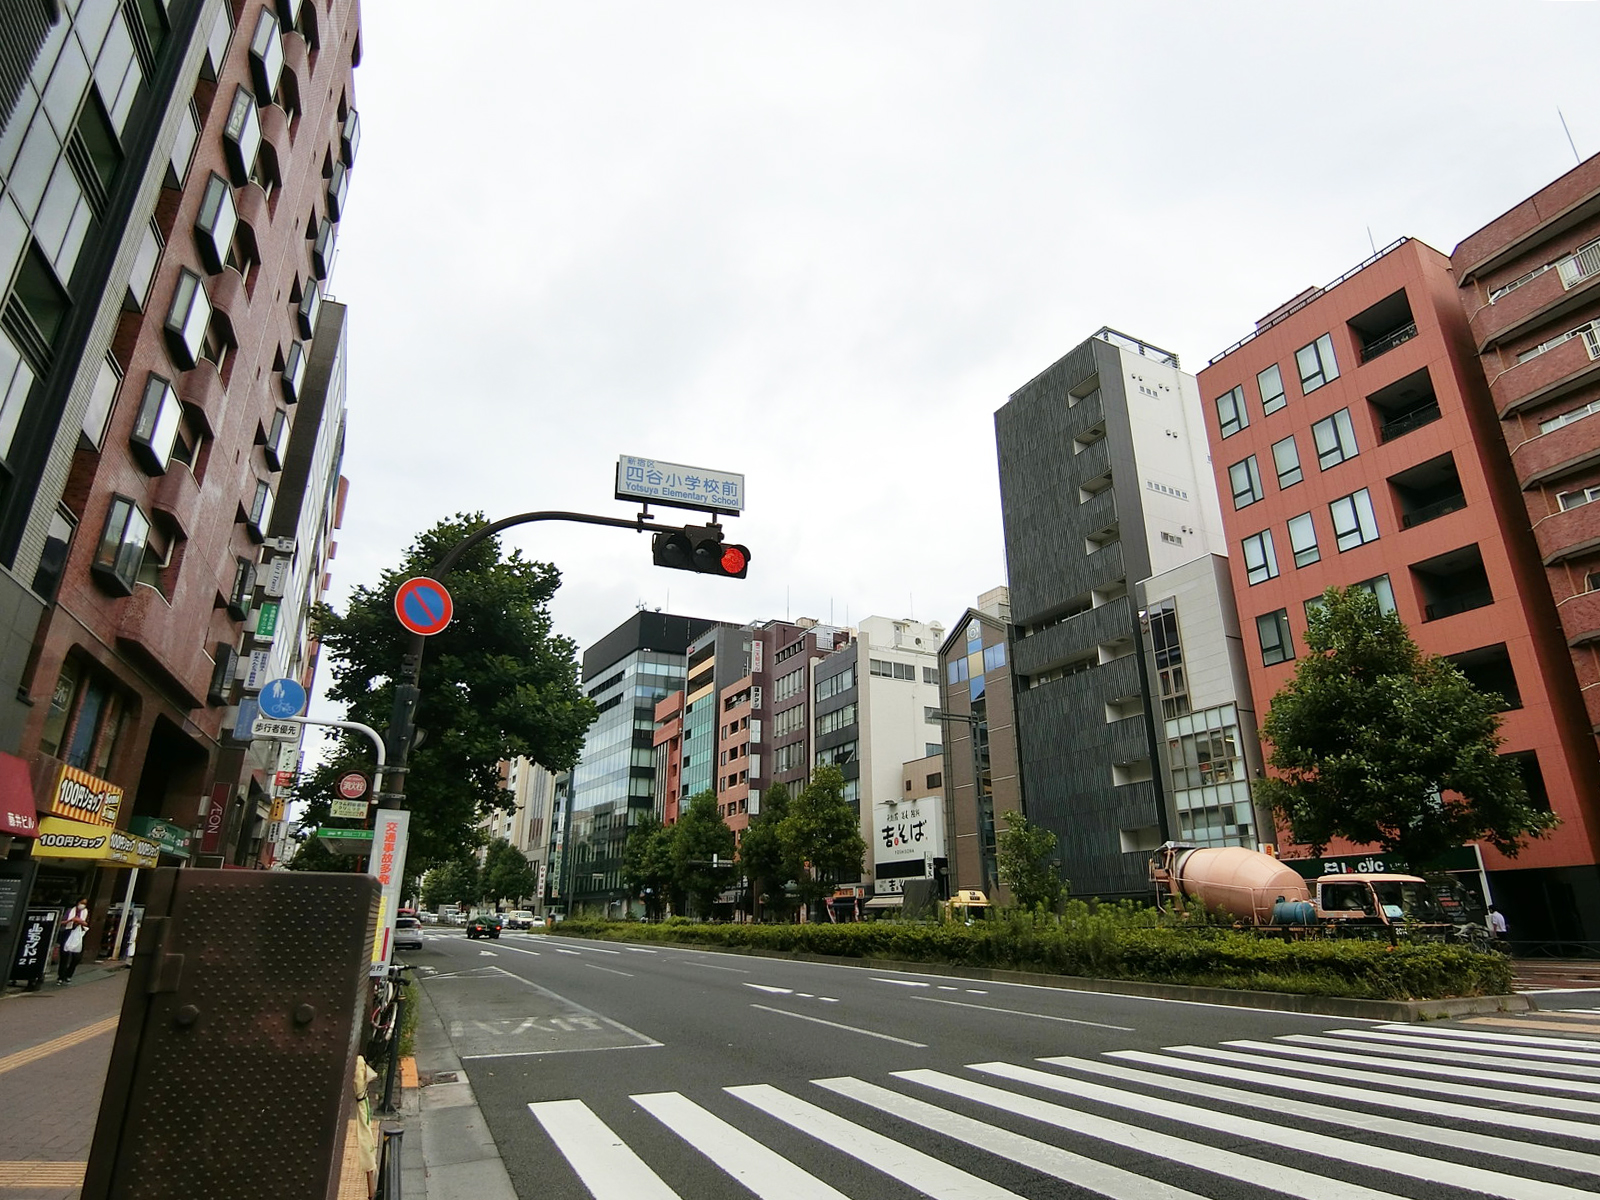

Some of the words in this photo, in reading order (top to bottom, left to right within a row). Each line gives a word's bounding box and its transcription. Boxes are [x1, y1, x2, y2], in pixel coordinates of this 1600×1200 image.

[625, 481, 659, 495] Yotsuya
[662, 487, 708, 504] Elementary
[711, 494, 739, 507] School
[626, 466, 738, 497] 四谷小学校前
[255, 722, 299, 736] 歩行者優先
[60, 778, 104, 813] 100円ショップ
[40, 834, 107, 849] 100円ショップ
[882, 819, 927, 848] 吉そば
[378, 822, 398, 885] 交通事故多発
